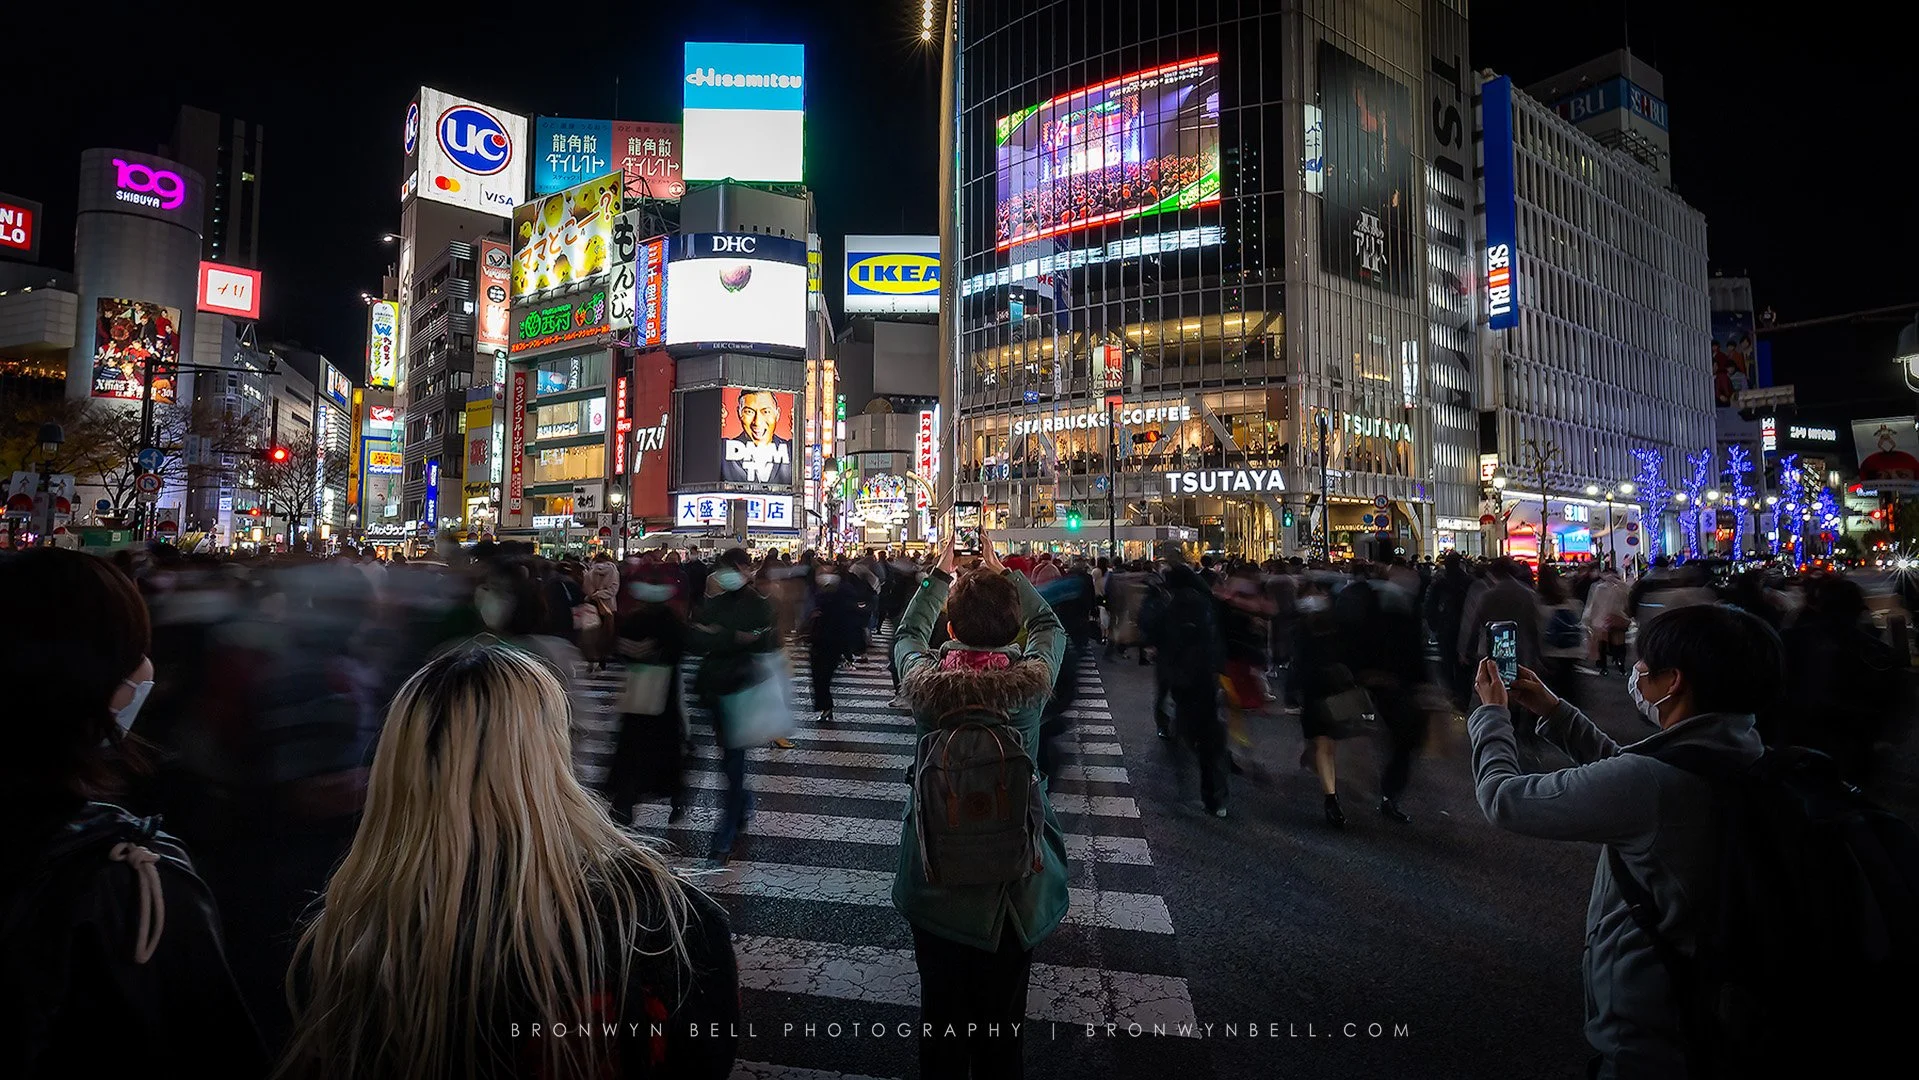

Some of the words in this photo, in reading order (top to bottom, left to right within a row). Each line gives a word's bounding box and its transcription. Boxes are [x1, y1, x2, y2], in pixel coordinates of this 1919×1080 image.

[686, 67, 803, 88] Hisamitsu
[447, 117, 505, 162] UC
[553, 133, 597, 154] 龍角散
[628, 136, 672, 158] 龍角散
[546, 153, 605, 174] ダイレクト
[621, 157, 680, 177] ダイレクト
[113, 158, 186, 210] 109
[116, 189, 160, 208] SHIBUYA
[485, 190, 515, 207] VISA
[712, 235, 756, 253] DHC
[611, 214, 637, 325] もんじゃ
[858, 265, 940, 282] IKEA
[1488, 243, 1511, 317] SEIBU
[645, 244, 660, 339] 三千里薬品
[541, 310, 571, 335] 西村
[1015, 410, 1110, 436] STARBUCKS
[1120, 405, 1191, 425] COFFEE
[1342, 411, 1411, 443] TSUTAYA
[633, 412, 669, 474] クスリ
[725, 439, 790, 464] DMM
[742, 461, 774, 483] TV
[1166, 469, 1285, 494] TSUTAYA
